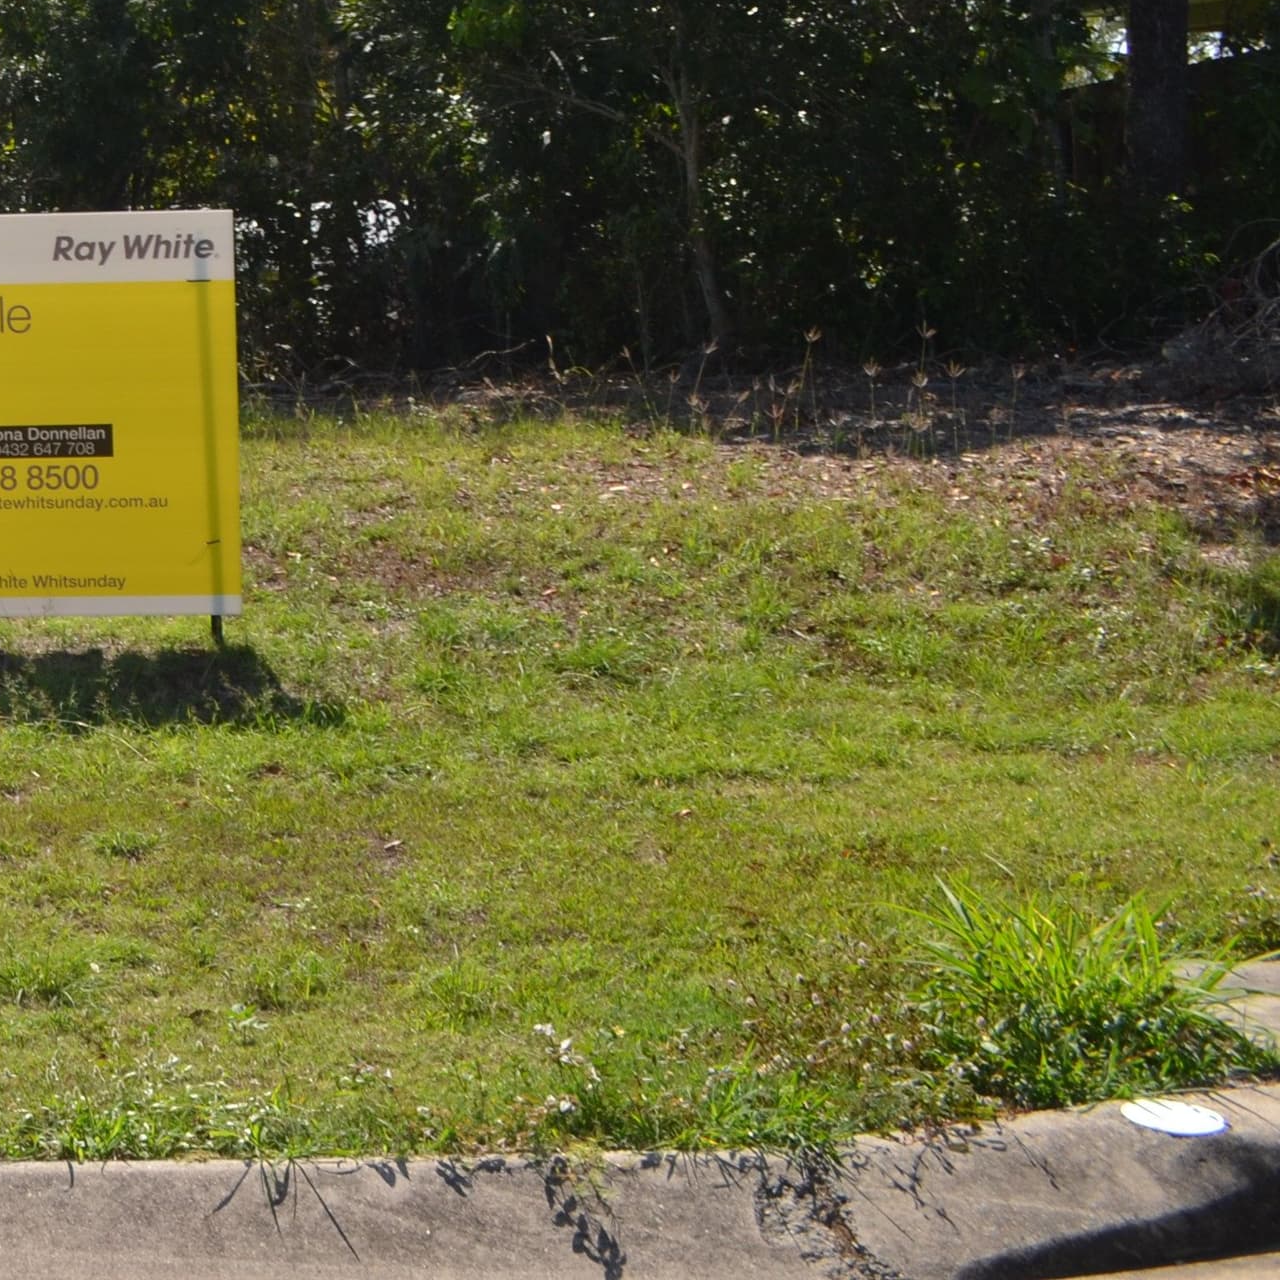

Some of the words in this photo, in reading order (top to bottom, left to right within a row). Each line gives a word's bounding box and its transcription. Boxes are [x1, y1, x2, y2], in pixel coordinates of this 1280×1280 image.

[52, 235, 116, 266] Ray
[123, 233, 215, 260] White
[27, 426, 106, 441] Donnellan
[67, 441, 96, 455] 708
[26, 464, 99, 490] 8500
[33, 574, 127, 590] Whitsunday
